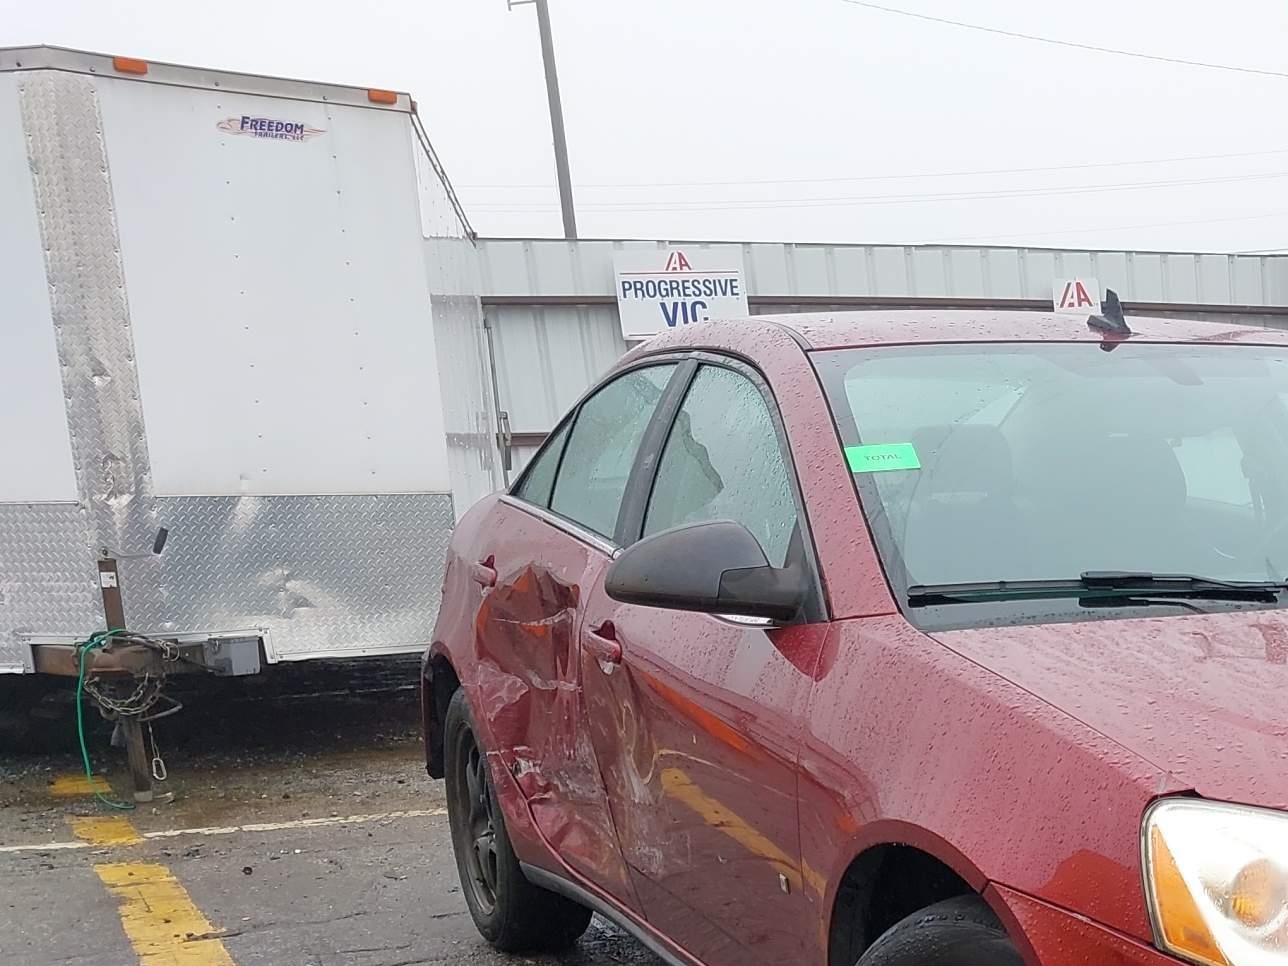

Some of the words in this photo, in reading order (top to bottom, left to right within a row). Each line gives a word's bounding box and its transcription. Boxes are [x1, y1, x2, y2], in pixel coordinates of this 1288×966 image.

[240, 115, 305, 135] FREEDOM
[621, 279, 740, 299] PROGRESSIVE
[660, 300, 709, 328] VIC
